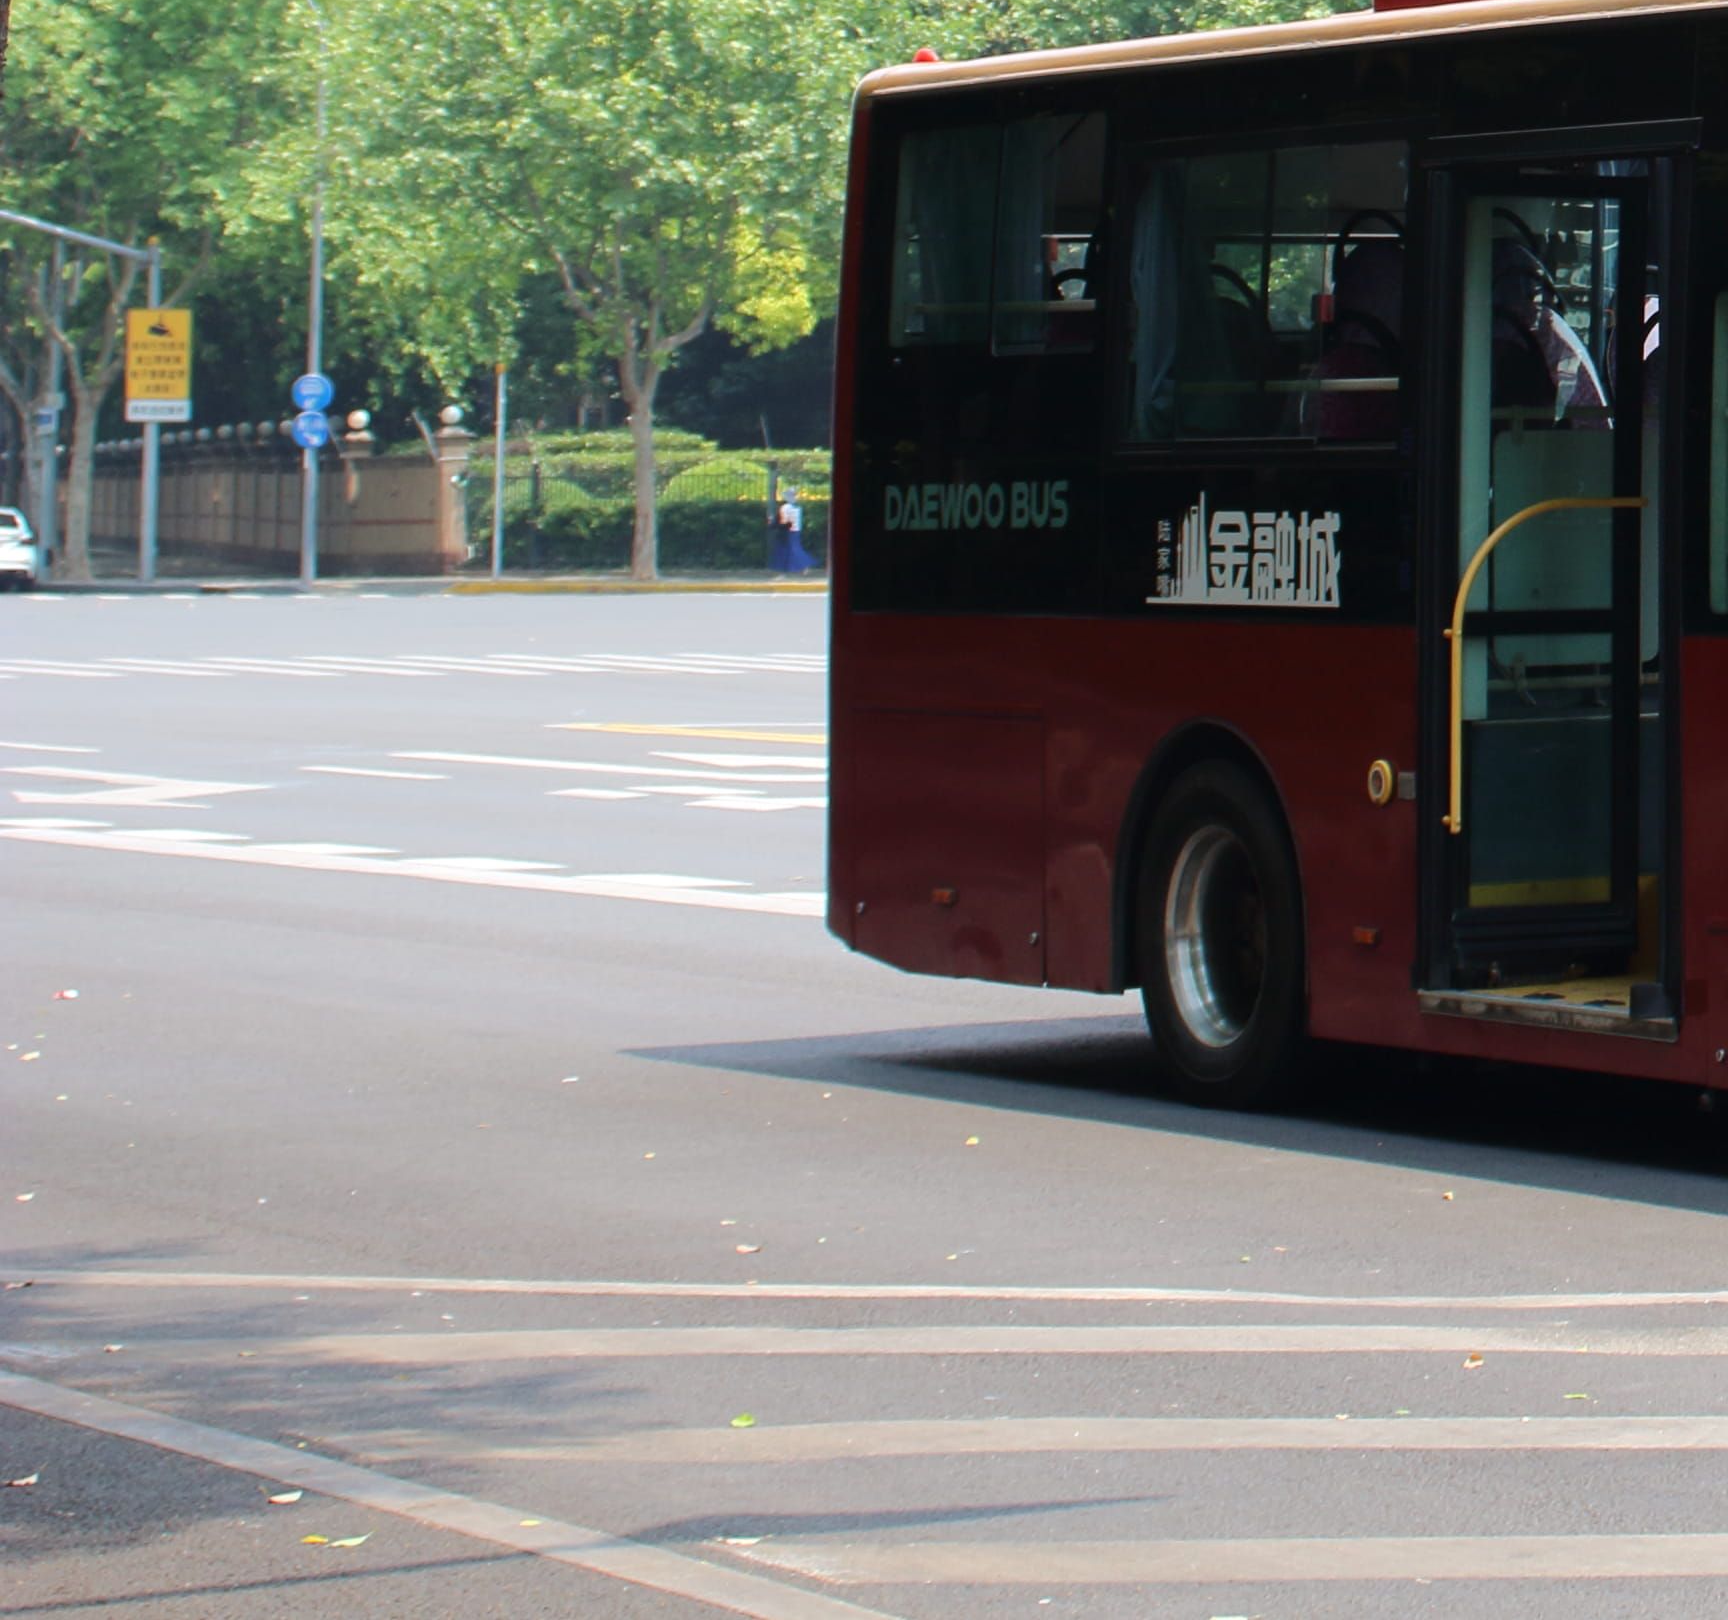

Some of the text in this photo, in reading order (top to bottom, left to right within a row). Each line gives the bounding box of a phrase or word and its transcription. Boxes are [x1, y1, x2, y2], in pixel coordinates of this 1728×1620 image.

[885, 481, 1069, 530] DAEWOO BUS
[1209, 510, 1341, 603] 金融城
